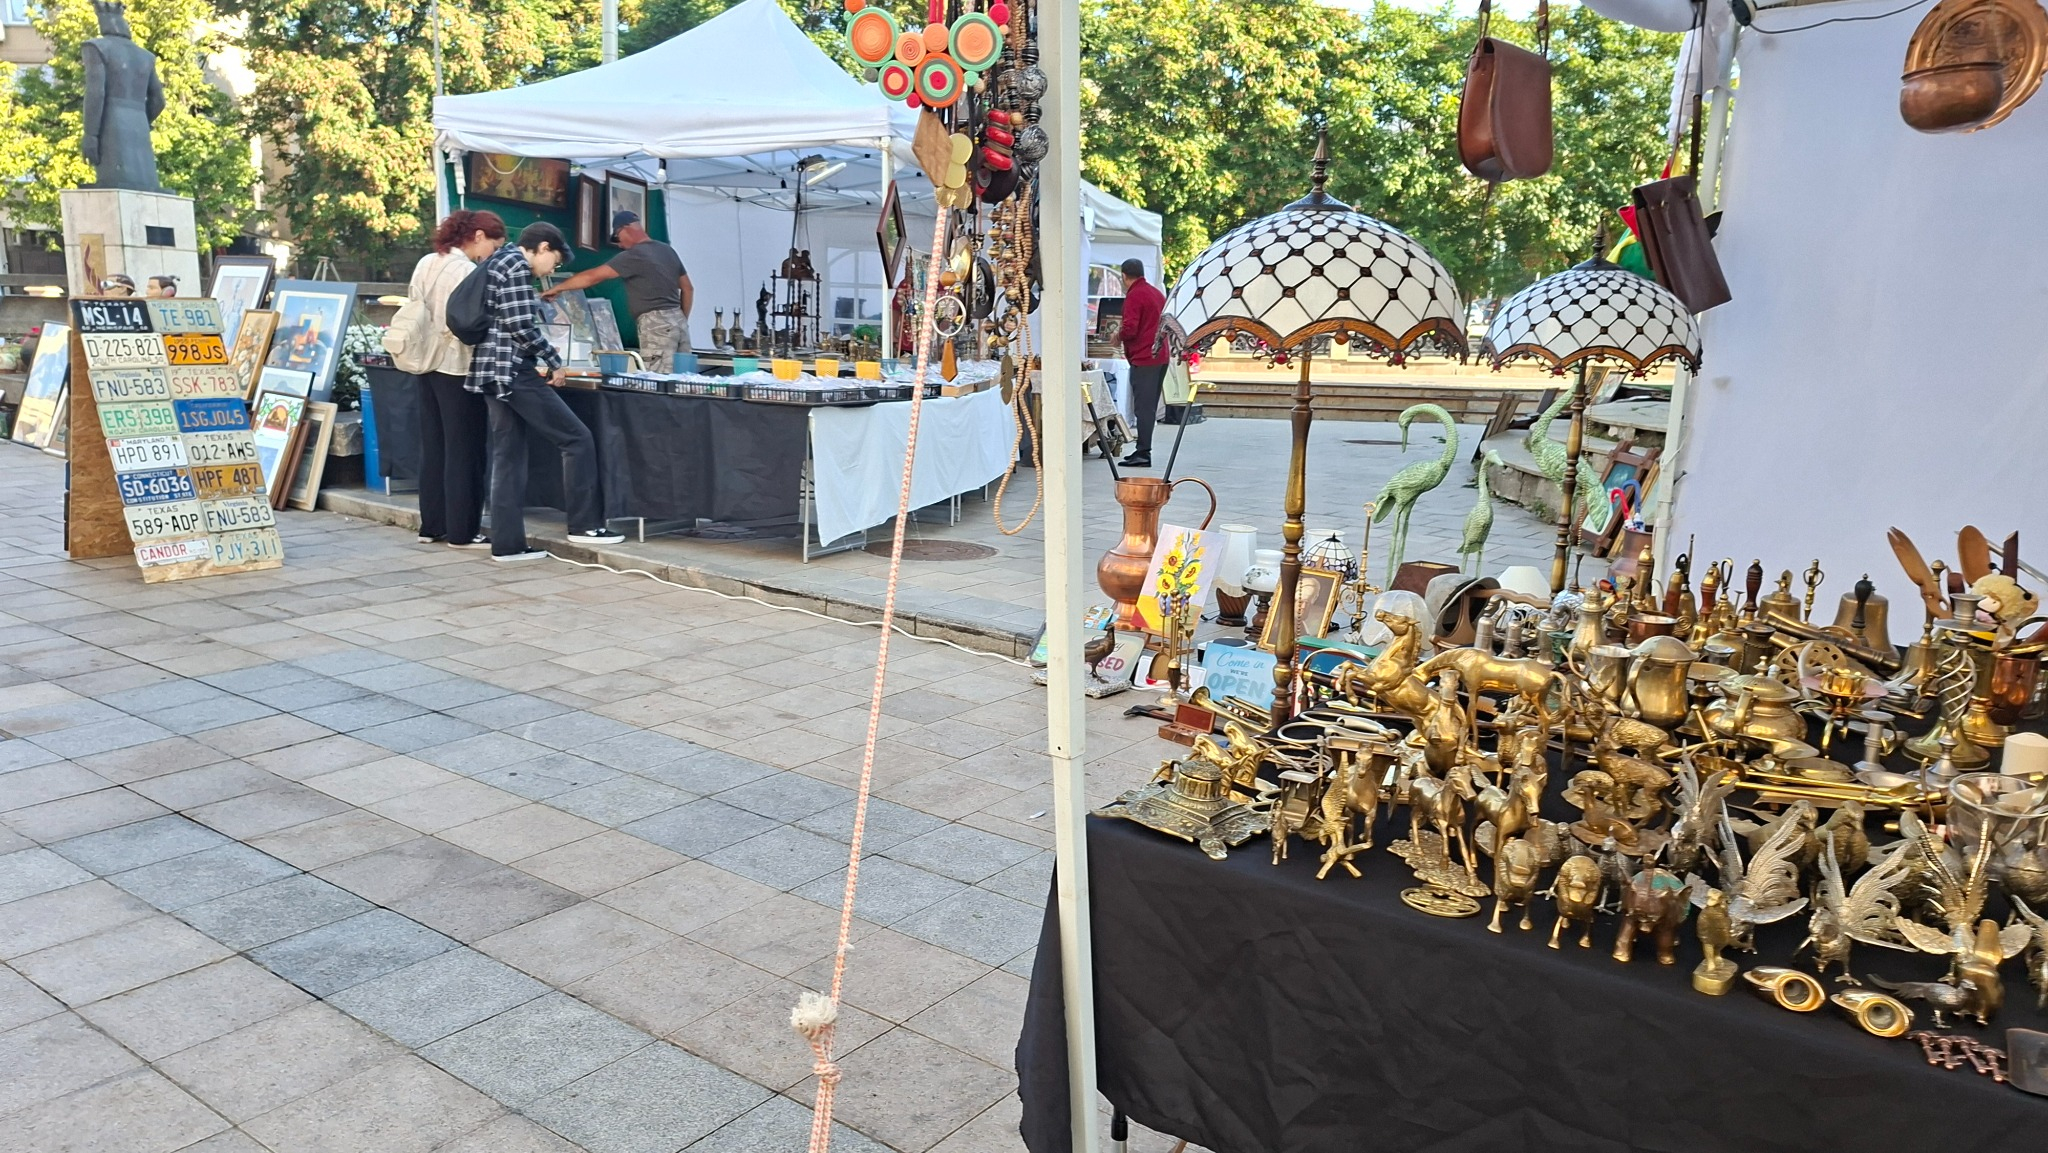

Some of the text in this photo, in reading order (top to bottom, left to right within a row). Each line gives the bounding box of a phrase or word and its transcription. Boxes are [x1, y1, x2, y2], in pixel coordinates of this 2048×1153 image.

[118, 356, 152, 364] CAROLINA
[167, 343, 223, 361] 998JS
[187, 367, 217, 375] TEXAS
[96, 378, 165, 397] FNU-583
[181, 409, 245, 428] 1SGJ045
[126, 437, 165, 445] MARYLAND
[205, 433, 234, 442] TEXAS
[116, 443, 180, 464] HPD 891
[132, 470, 173, 480] CONNECTICUT
[196, 467, 259, 488] HPF 487
[147, 504, 179, 515] TEXAS
[206, 505, 271, 527] FNU-583
[229, 532, 259, 541] TEXAS
[139, 543, 188, 561] CANDOR
[1216, 651, 1265, 668] Come in
[1208, 672, 1266, 699] OPEN
